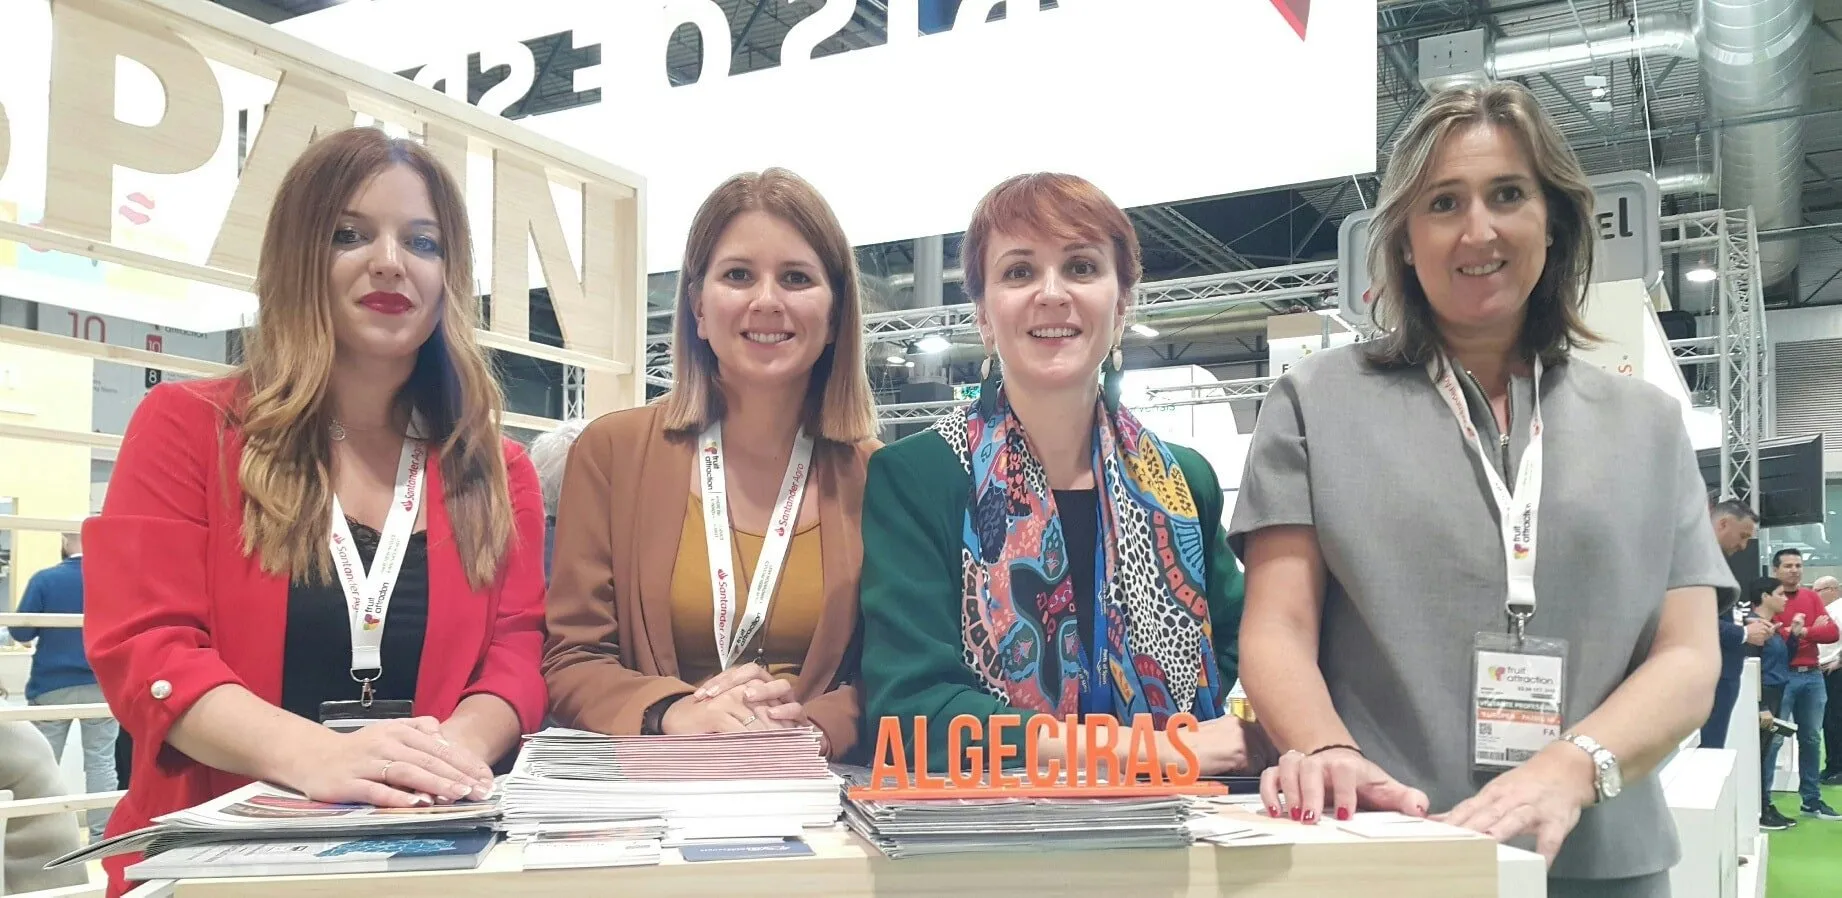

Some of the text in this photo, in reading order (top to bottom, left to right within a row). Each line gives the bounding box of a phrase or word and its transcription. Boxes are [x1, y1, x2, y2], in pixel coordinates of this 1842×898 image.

[0, 0, 613, 352] PAIN
[148, 370, 158, 385] 8
[779, 463, 804, 527] Santander Agro
[717, 581, 728, 632] Santander
[1506, 674, 1554, 685] attraction
[871, 713, 1200, 789] ALGECIRAS
[1543, 728, 1556, 737] FA
